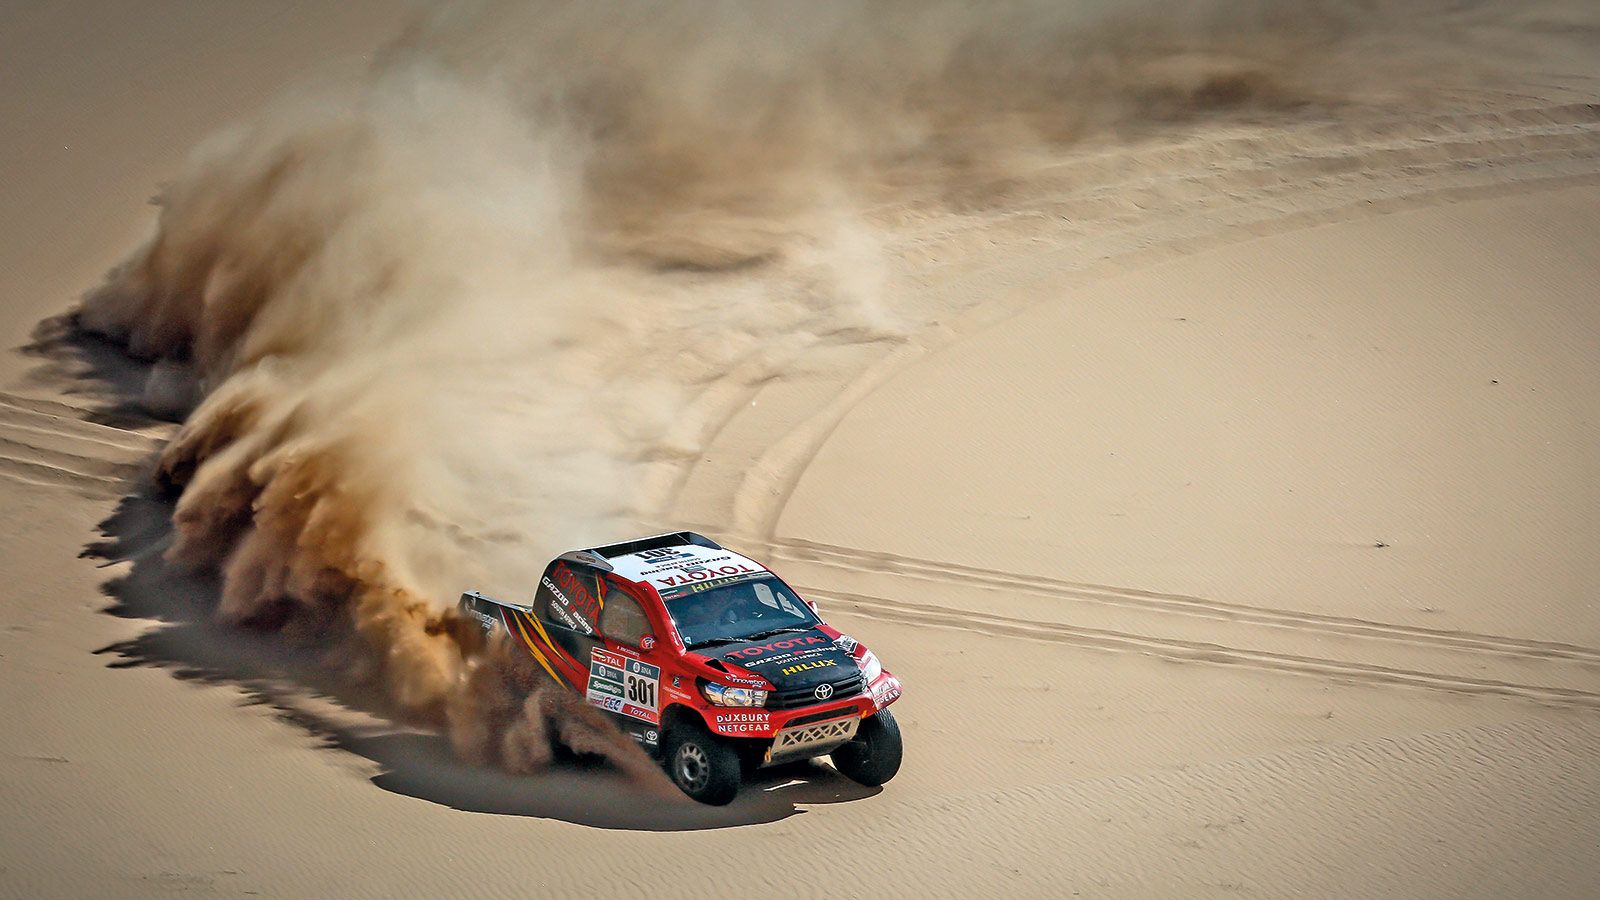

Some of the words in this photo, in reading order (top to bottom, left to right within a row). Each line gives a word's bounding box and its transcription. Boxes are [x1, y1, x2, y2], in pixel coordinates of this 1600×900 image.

[635, 549, 680, 560] 301
[657, 564, 755, 587] TOYOTA
[552, 560, 600, 626] TOYOTA
[542, 576, 569, 606] GAZOO
[568, 604, 593, 634] Racing
[725, 636, 826, 659] TOYOTA
[744, 653, 792, 668] GAZOO
[793, 646, 837, 656] Racing
[597, 653, 622, 667] OTAL
[782, 659, 838, 676] HILUX
[627, 676, 655, 707] 301
[630, 707, 652, 720] TOTAL
[716, 713, 771, 723] DUXBURY
[718, 724, 771, 732] NETGEAR
